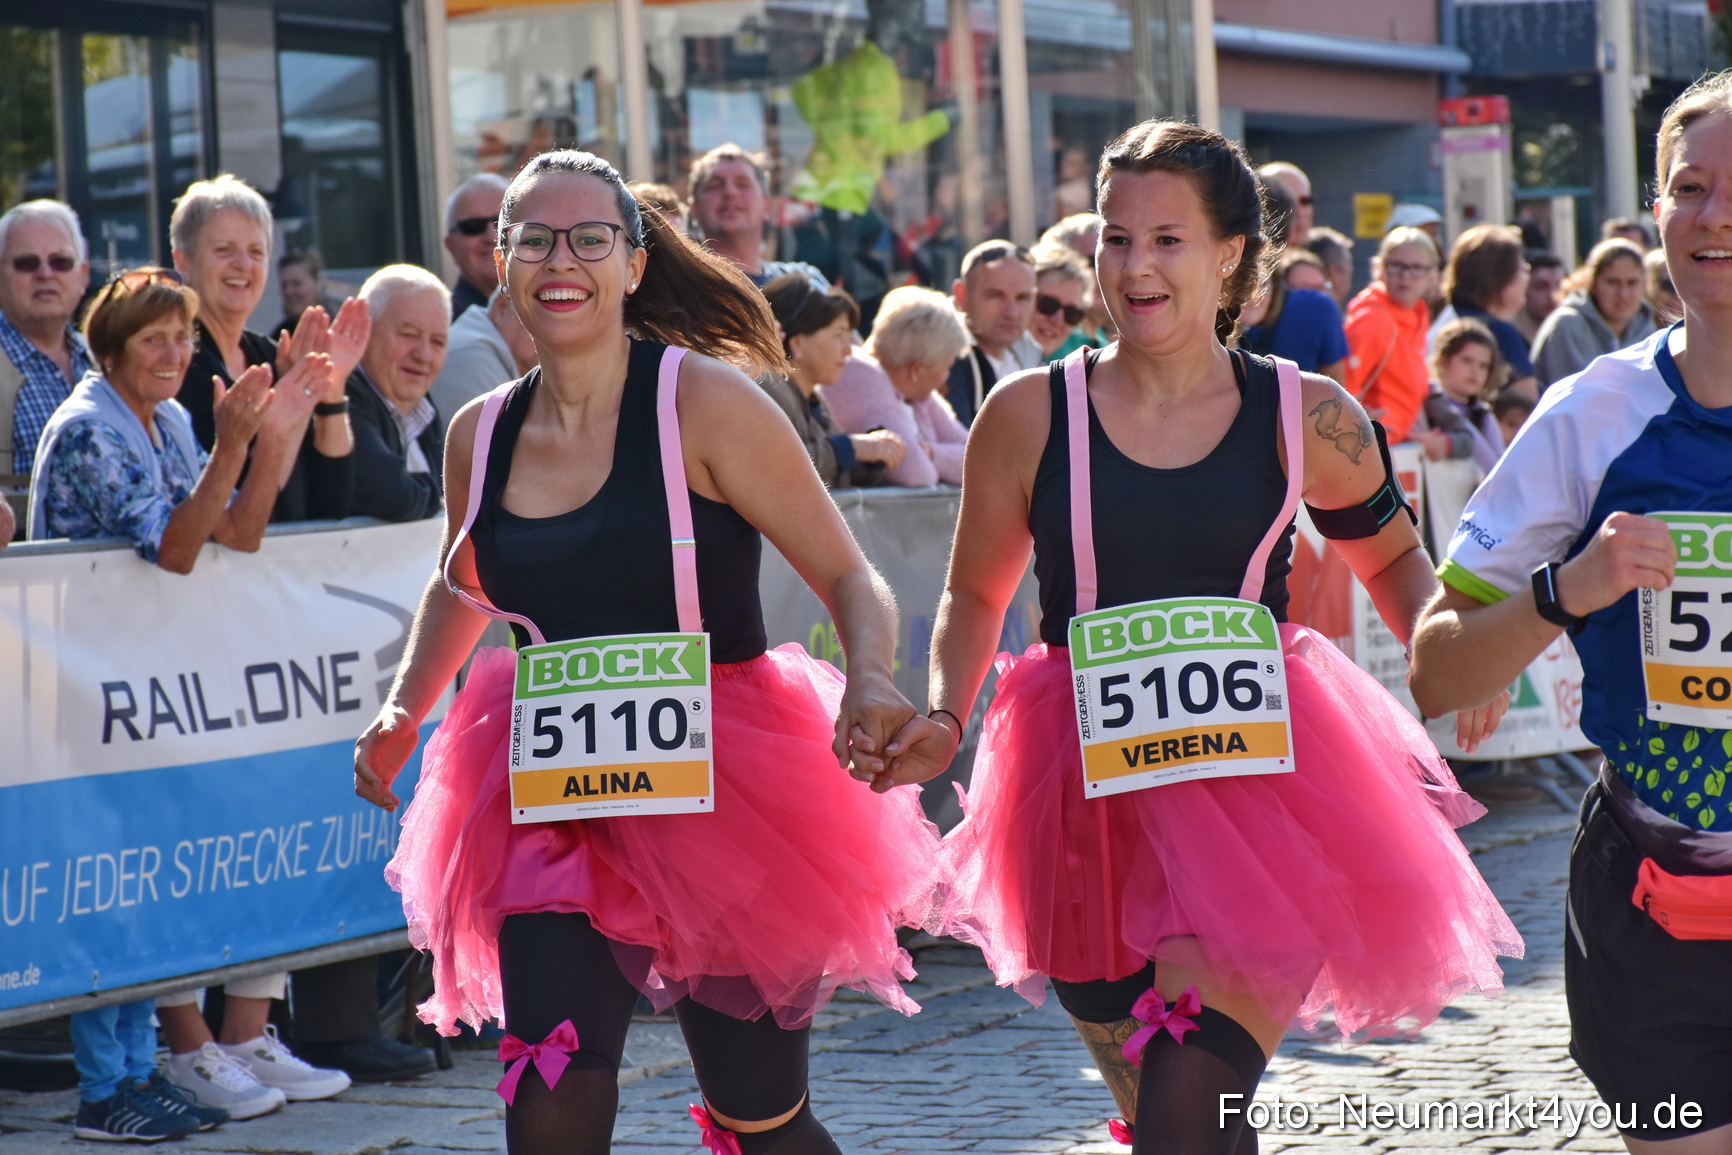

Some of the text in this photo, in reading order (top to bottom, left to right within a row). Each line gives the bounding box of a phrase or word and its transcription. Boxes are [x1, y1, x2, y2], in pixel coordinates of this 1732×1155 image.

[1086, 608, 1258, 657] BOCK
[1669, 590, 1732, 652] 5
[102, 651, 362, 744] RAIL.ONE
[531, 645, 687, 689] BOCK
[1100, 660, 1263, 729] 5106
[532, 698, 688, 759] 5110
[1121, 732, 1248, 768] VERENA
[563, 771, 654, 798] ALINA
[57, 846, 161, 924] JEDER
[171, 820, 313, 899] STRECKE
